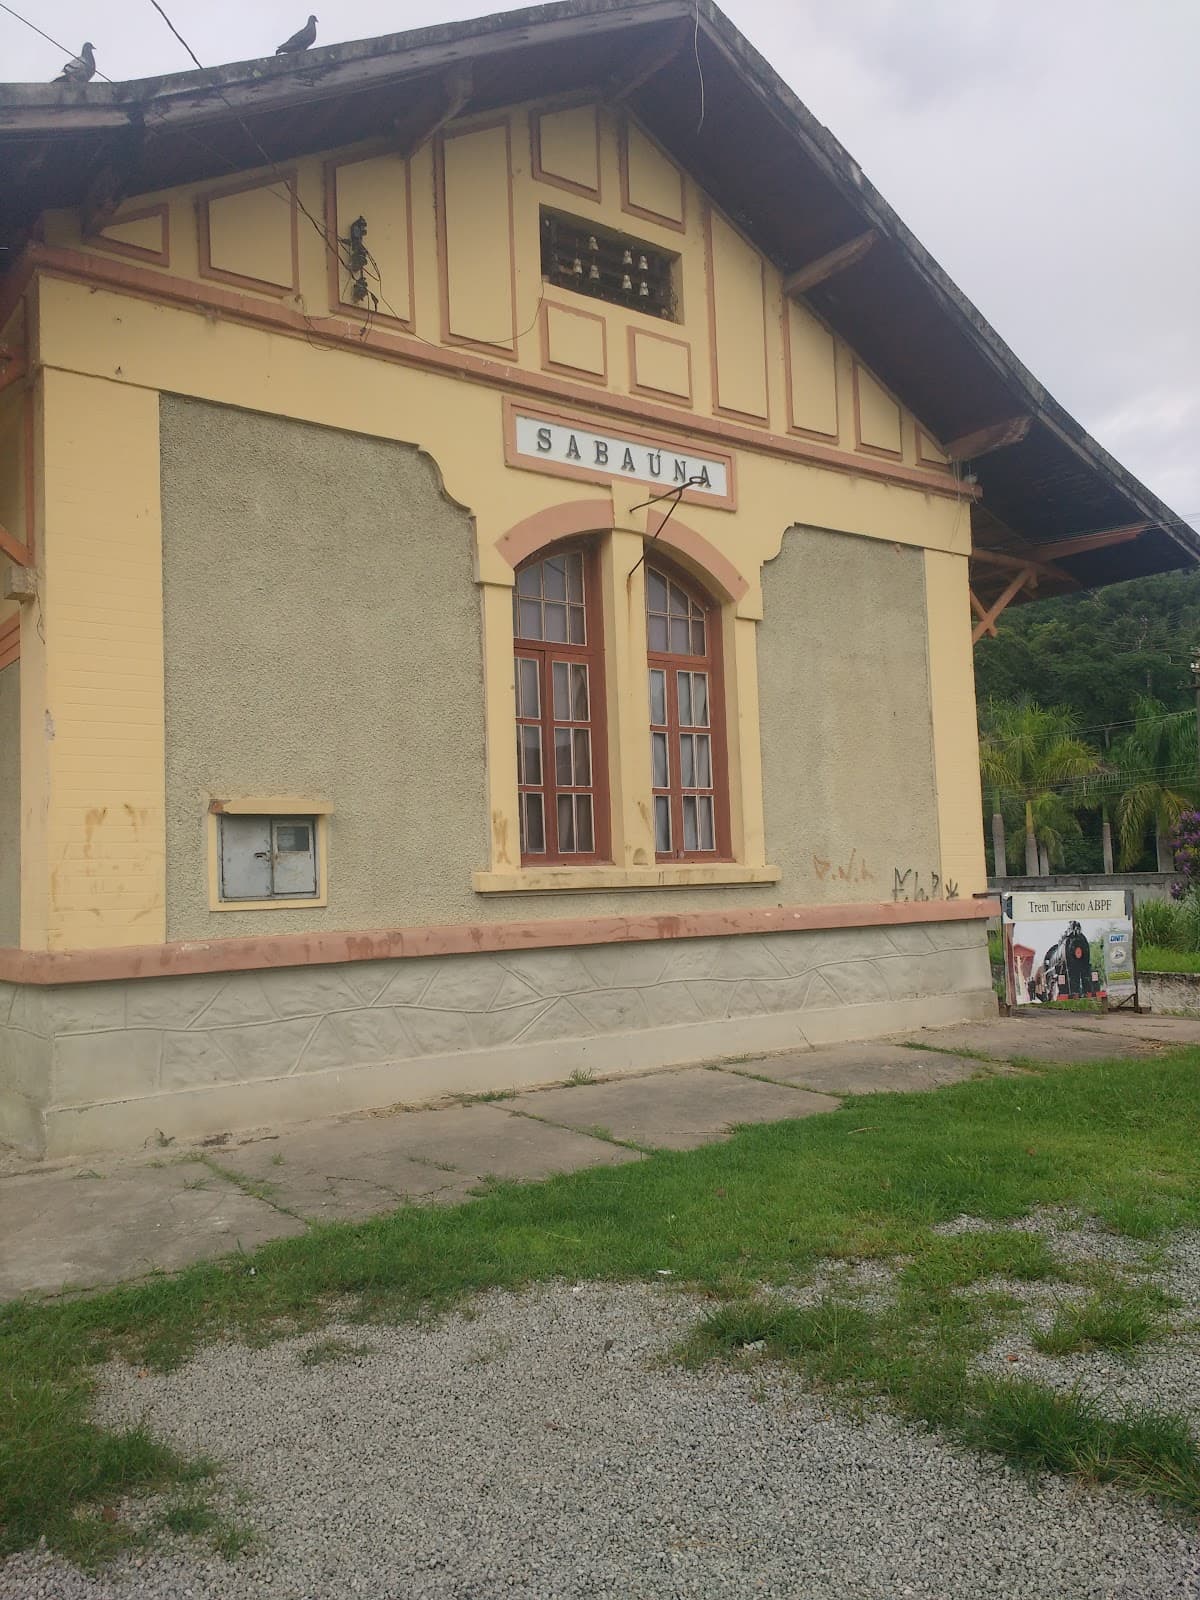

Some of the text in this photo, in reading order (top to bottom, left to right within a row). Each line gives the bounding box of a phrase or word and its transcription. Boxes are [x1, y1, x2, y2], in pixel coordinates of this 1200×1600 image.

[536, 427, 712, 488] SABAÚNA
[1028, 901, 1049, 913] Trem
[1087, 899, 1112, 911] ABPF
